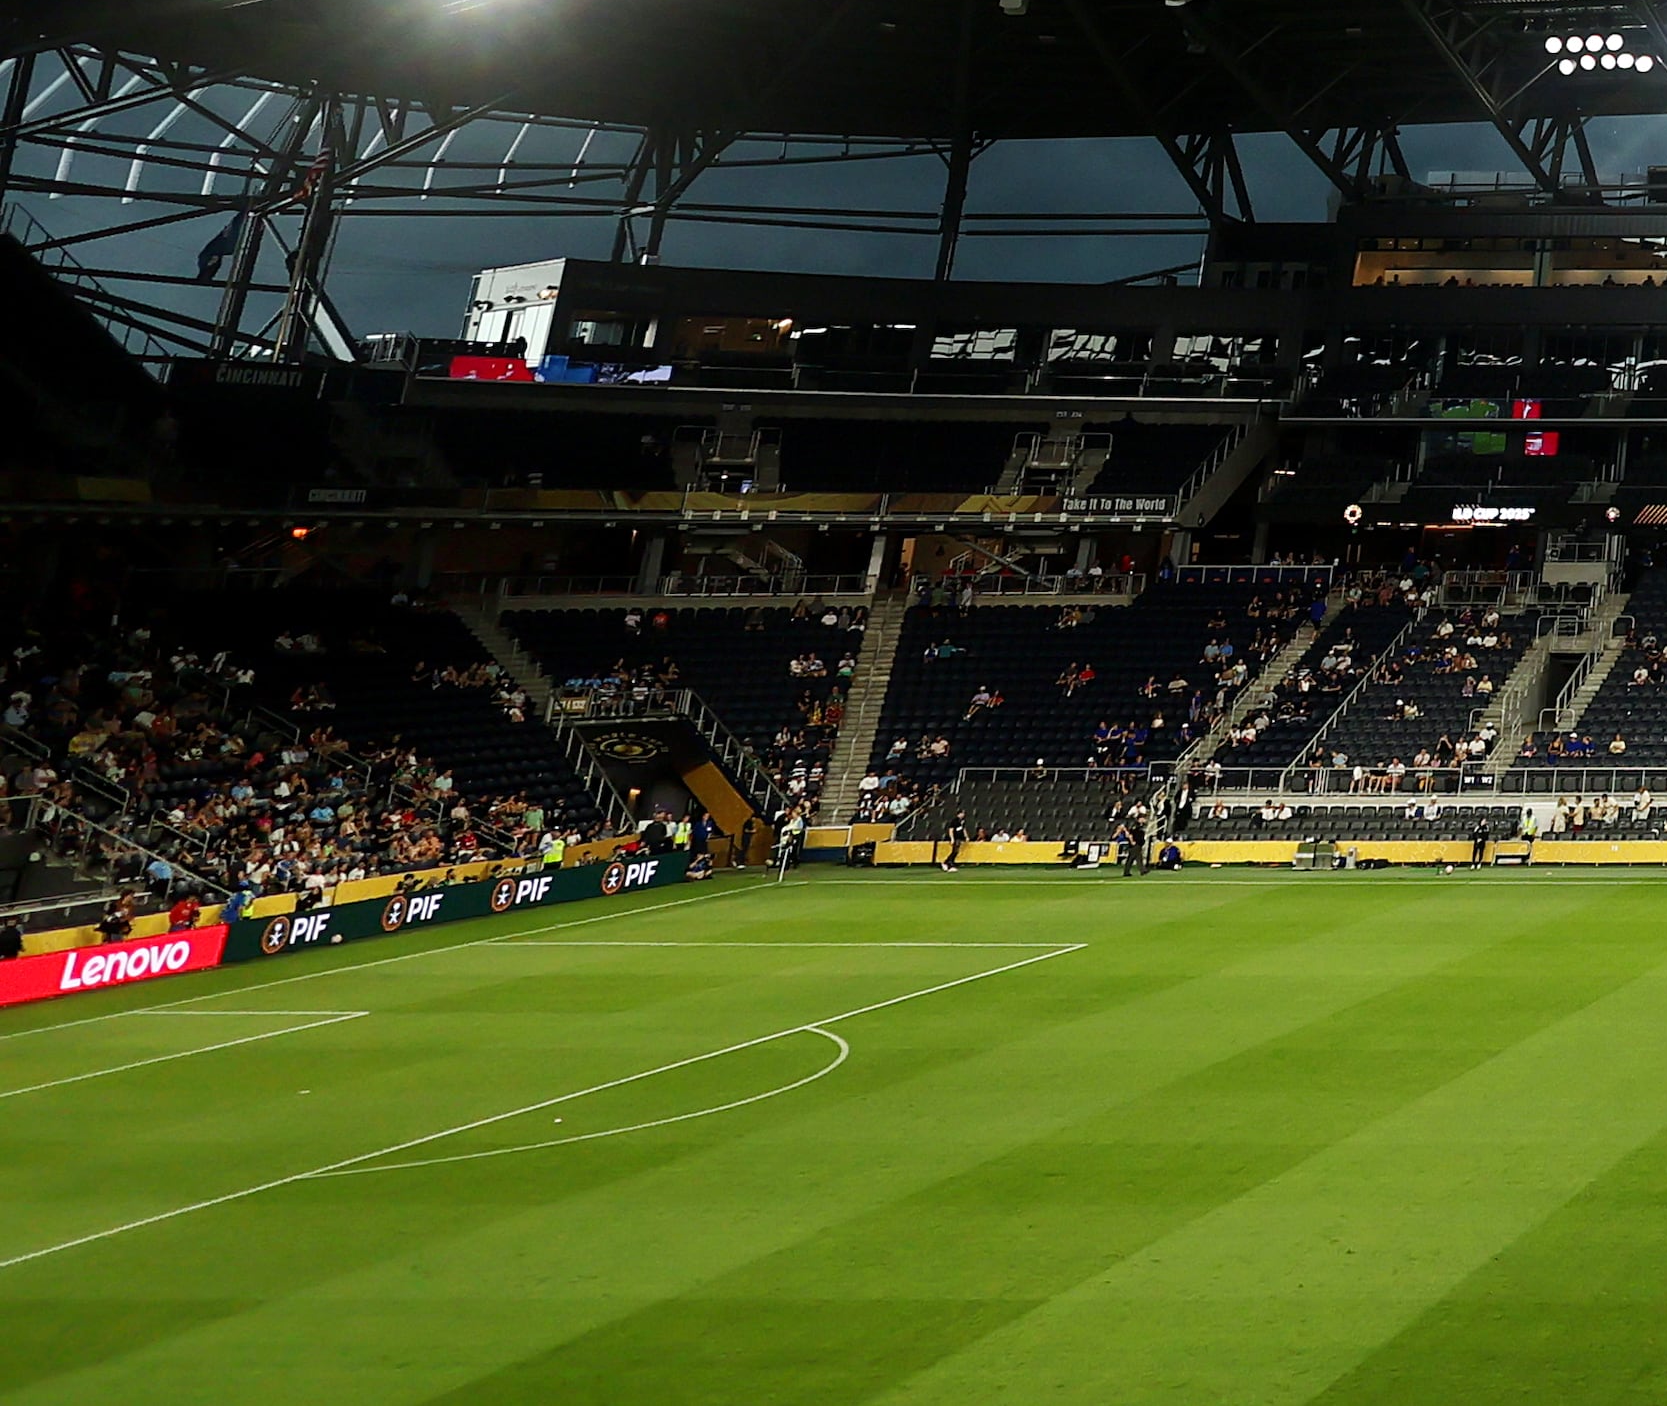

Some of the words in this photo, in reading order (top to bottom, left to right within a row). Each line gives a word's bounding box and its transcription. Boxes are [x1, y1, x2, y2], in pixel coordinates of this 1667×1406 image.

[217, 367, 303, 387] CINCINNATI
[1062, 498, 1087, 511] Take
[1089, 498, 1098, 510] It
[1100, 498, 1112, 510] To
[1115, 498, 1133, 510] The
[1136, 498, 1166, 511] World
[1453, 508, 1472, 520] LD
[1474, 508, 1498, 520] CUP
[624, 860, 660, 888] PIF
[515, 876, 554, 905] PIF
[405, 893, 444, 922] PIF
[289, 913, 331, 945] PIF
[60, 941, 190, 990] Lenovo
